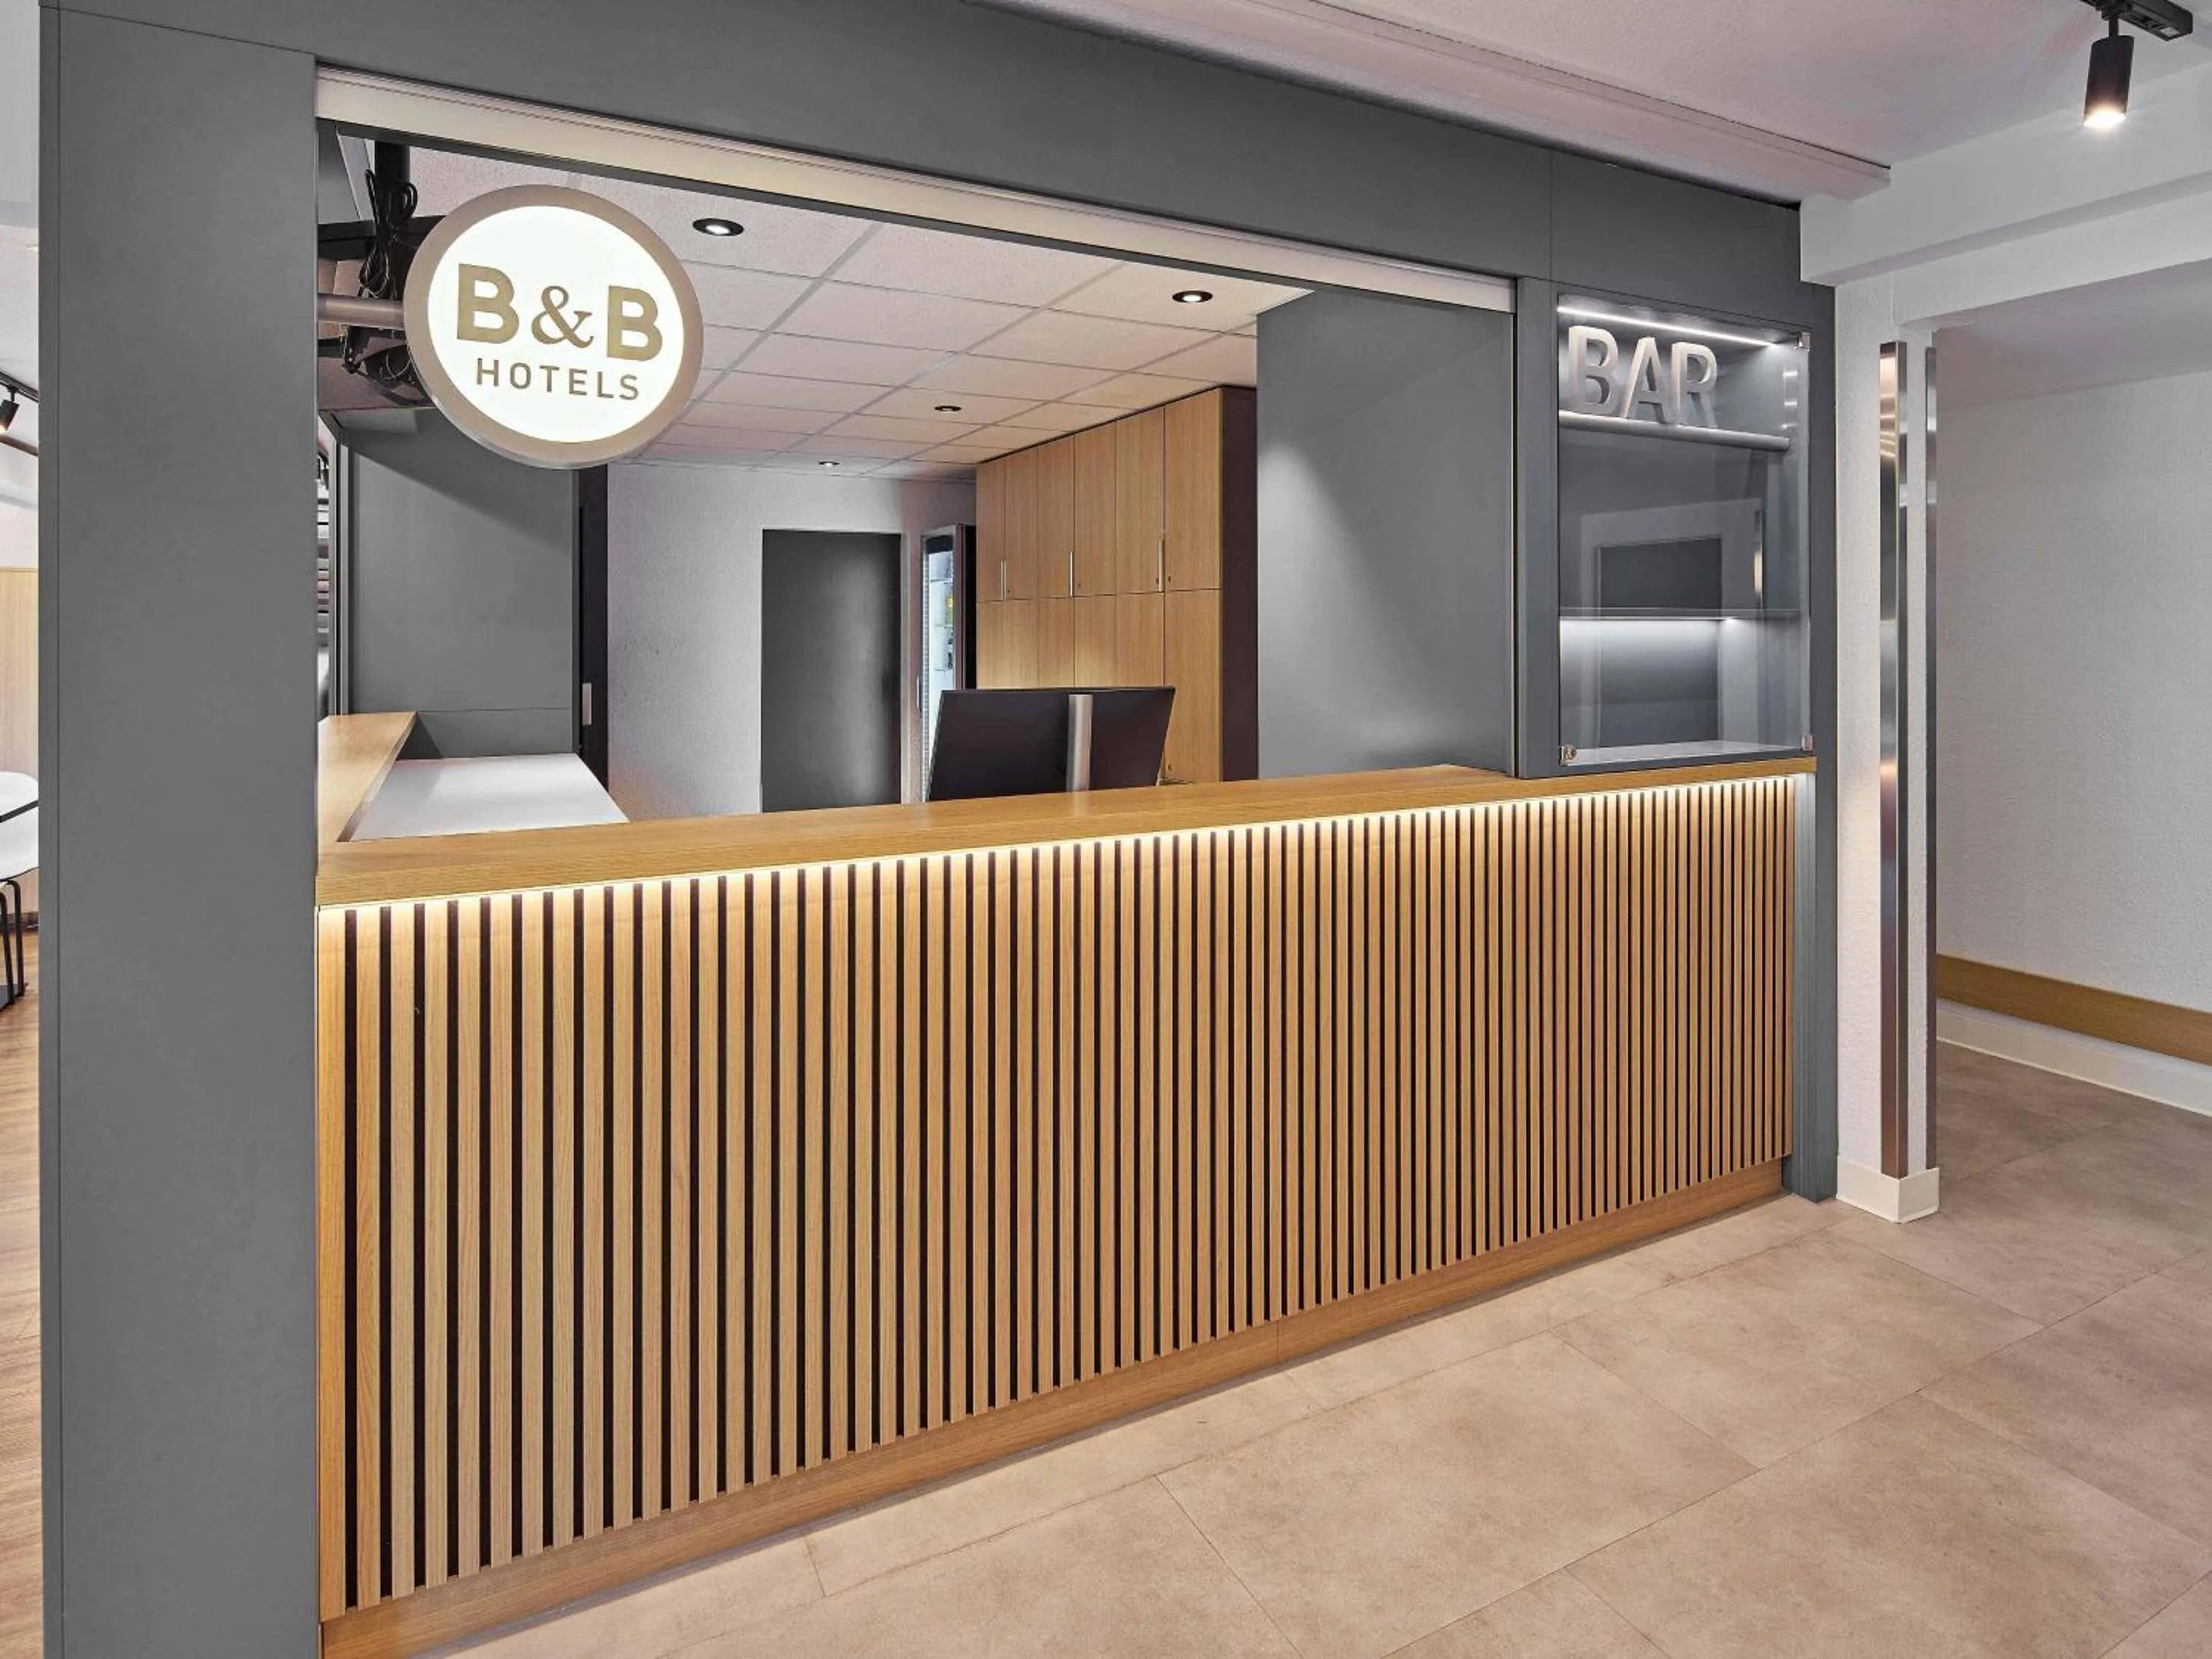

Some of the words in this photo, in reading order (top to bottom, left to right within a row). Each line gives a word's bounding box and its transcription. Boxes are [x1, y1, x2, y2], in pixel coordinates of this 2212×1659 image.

[456, 262, 663, 362] B&B
[476, 358, 639, 401] HOTELS
[1568, 325, 1718, 428] BAR
